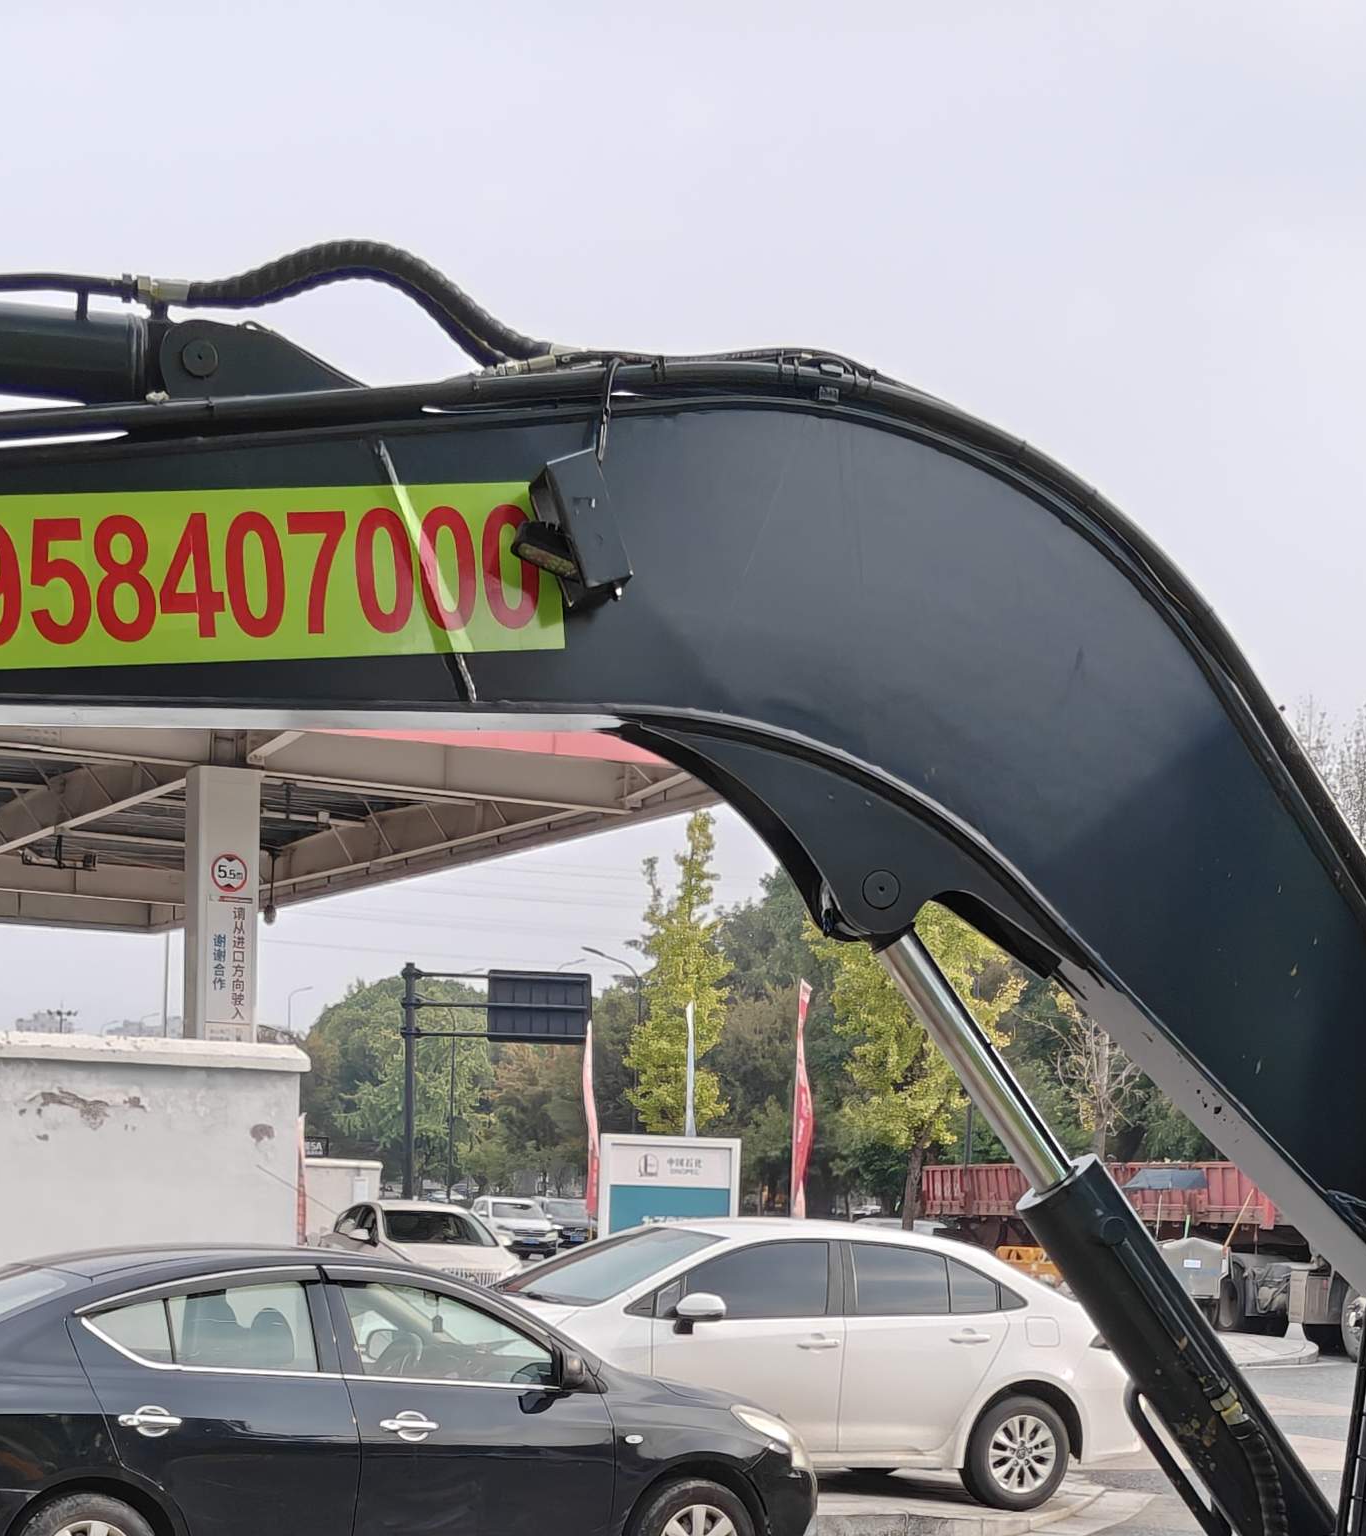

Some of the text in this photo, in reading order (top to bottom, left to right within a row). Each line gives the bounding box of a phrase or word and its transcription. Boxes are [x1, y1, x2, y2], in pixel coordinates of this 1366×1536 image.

[212, 934, 227, 991] 谢谢合作
[232, 906, 246, 1020] 请从进口方向驶入
